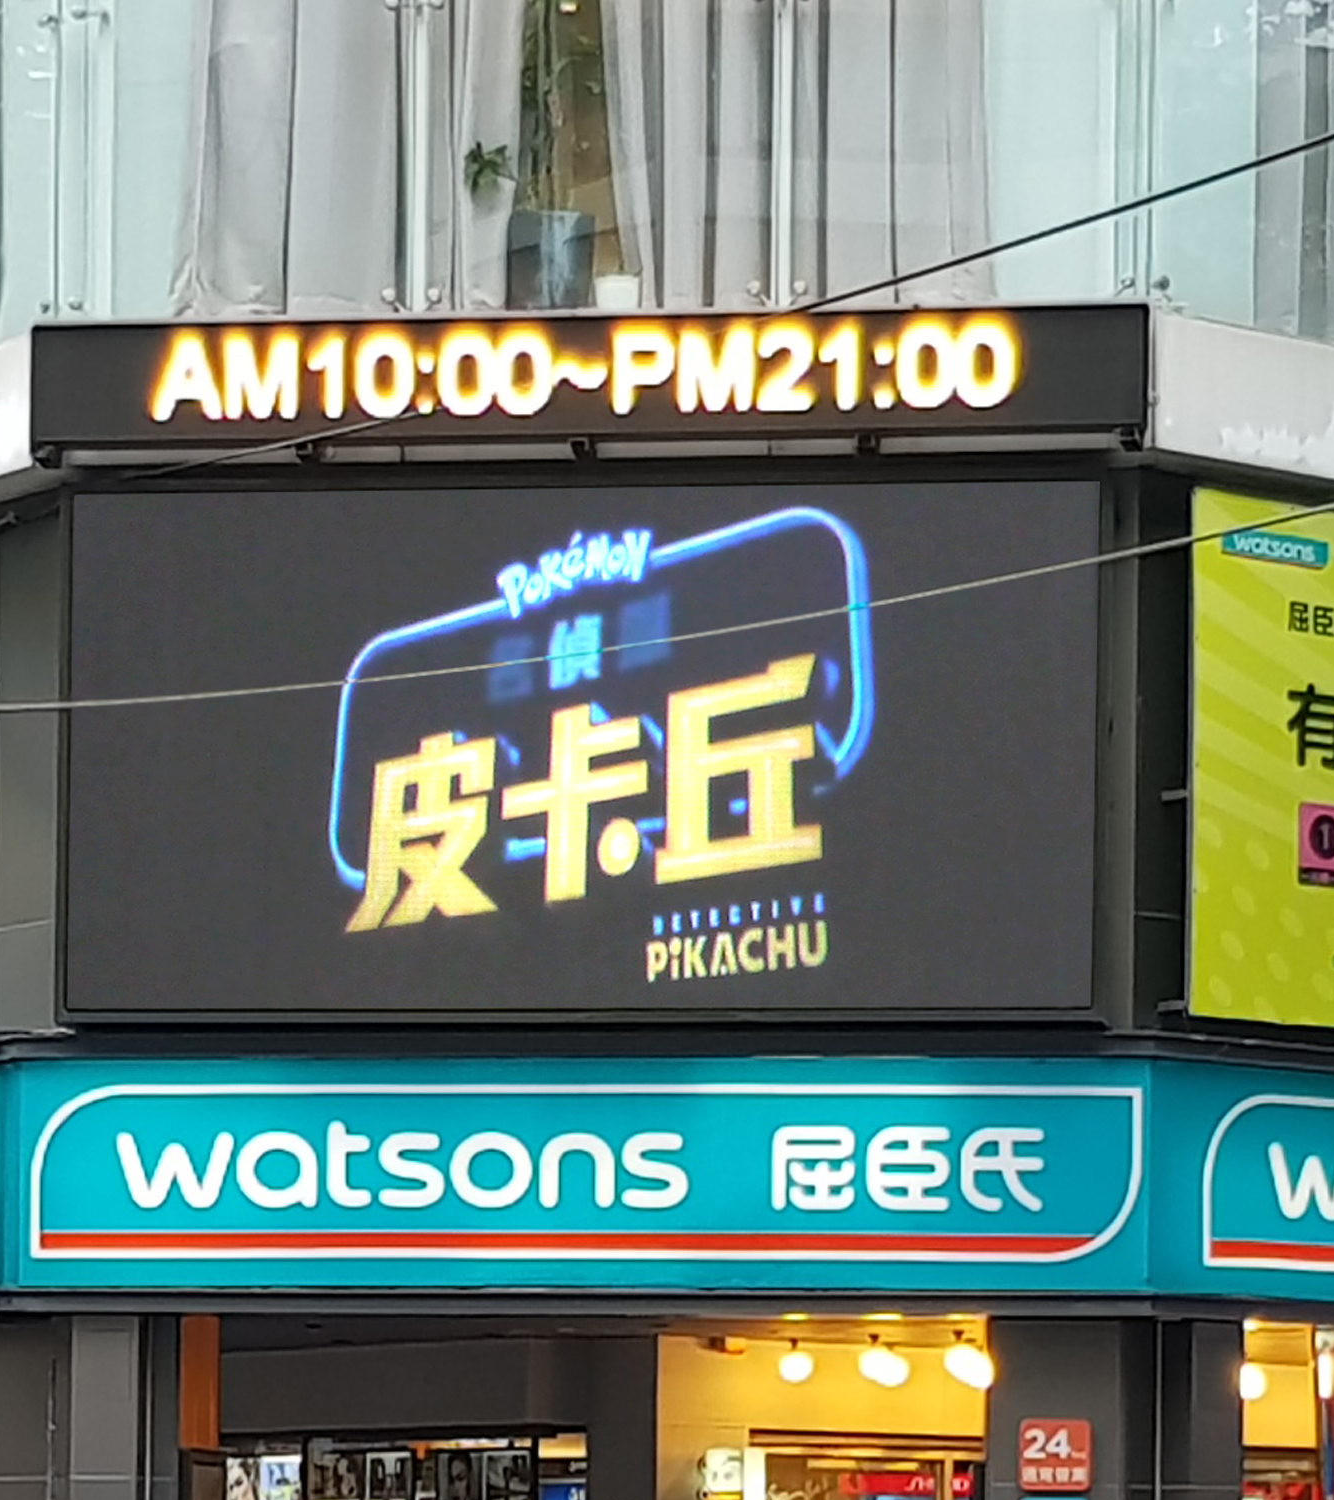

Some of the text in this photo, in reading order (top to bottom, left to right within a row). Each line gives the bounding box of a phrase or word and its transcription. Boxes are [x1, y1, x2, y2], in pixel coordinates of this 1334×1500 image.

[149, 318, 1019, 420] AM10:00~PM21:00
[1228, 530, 1317, 565] watsons
[345, 653, 825, 934] 皮卡丘
[653, 892, 825, 936] DETECTIVE
[117, 1120, 1045, 1212] watsons 屈臣氏
[1022, 1427, 1071, 1459] 24
